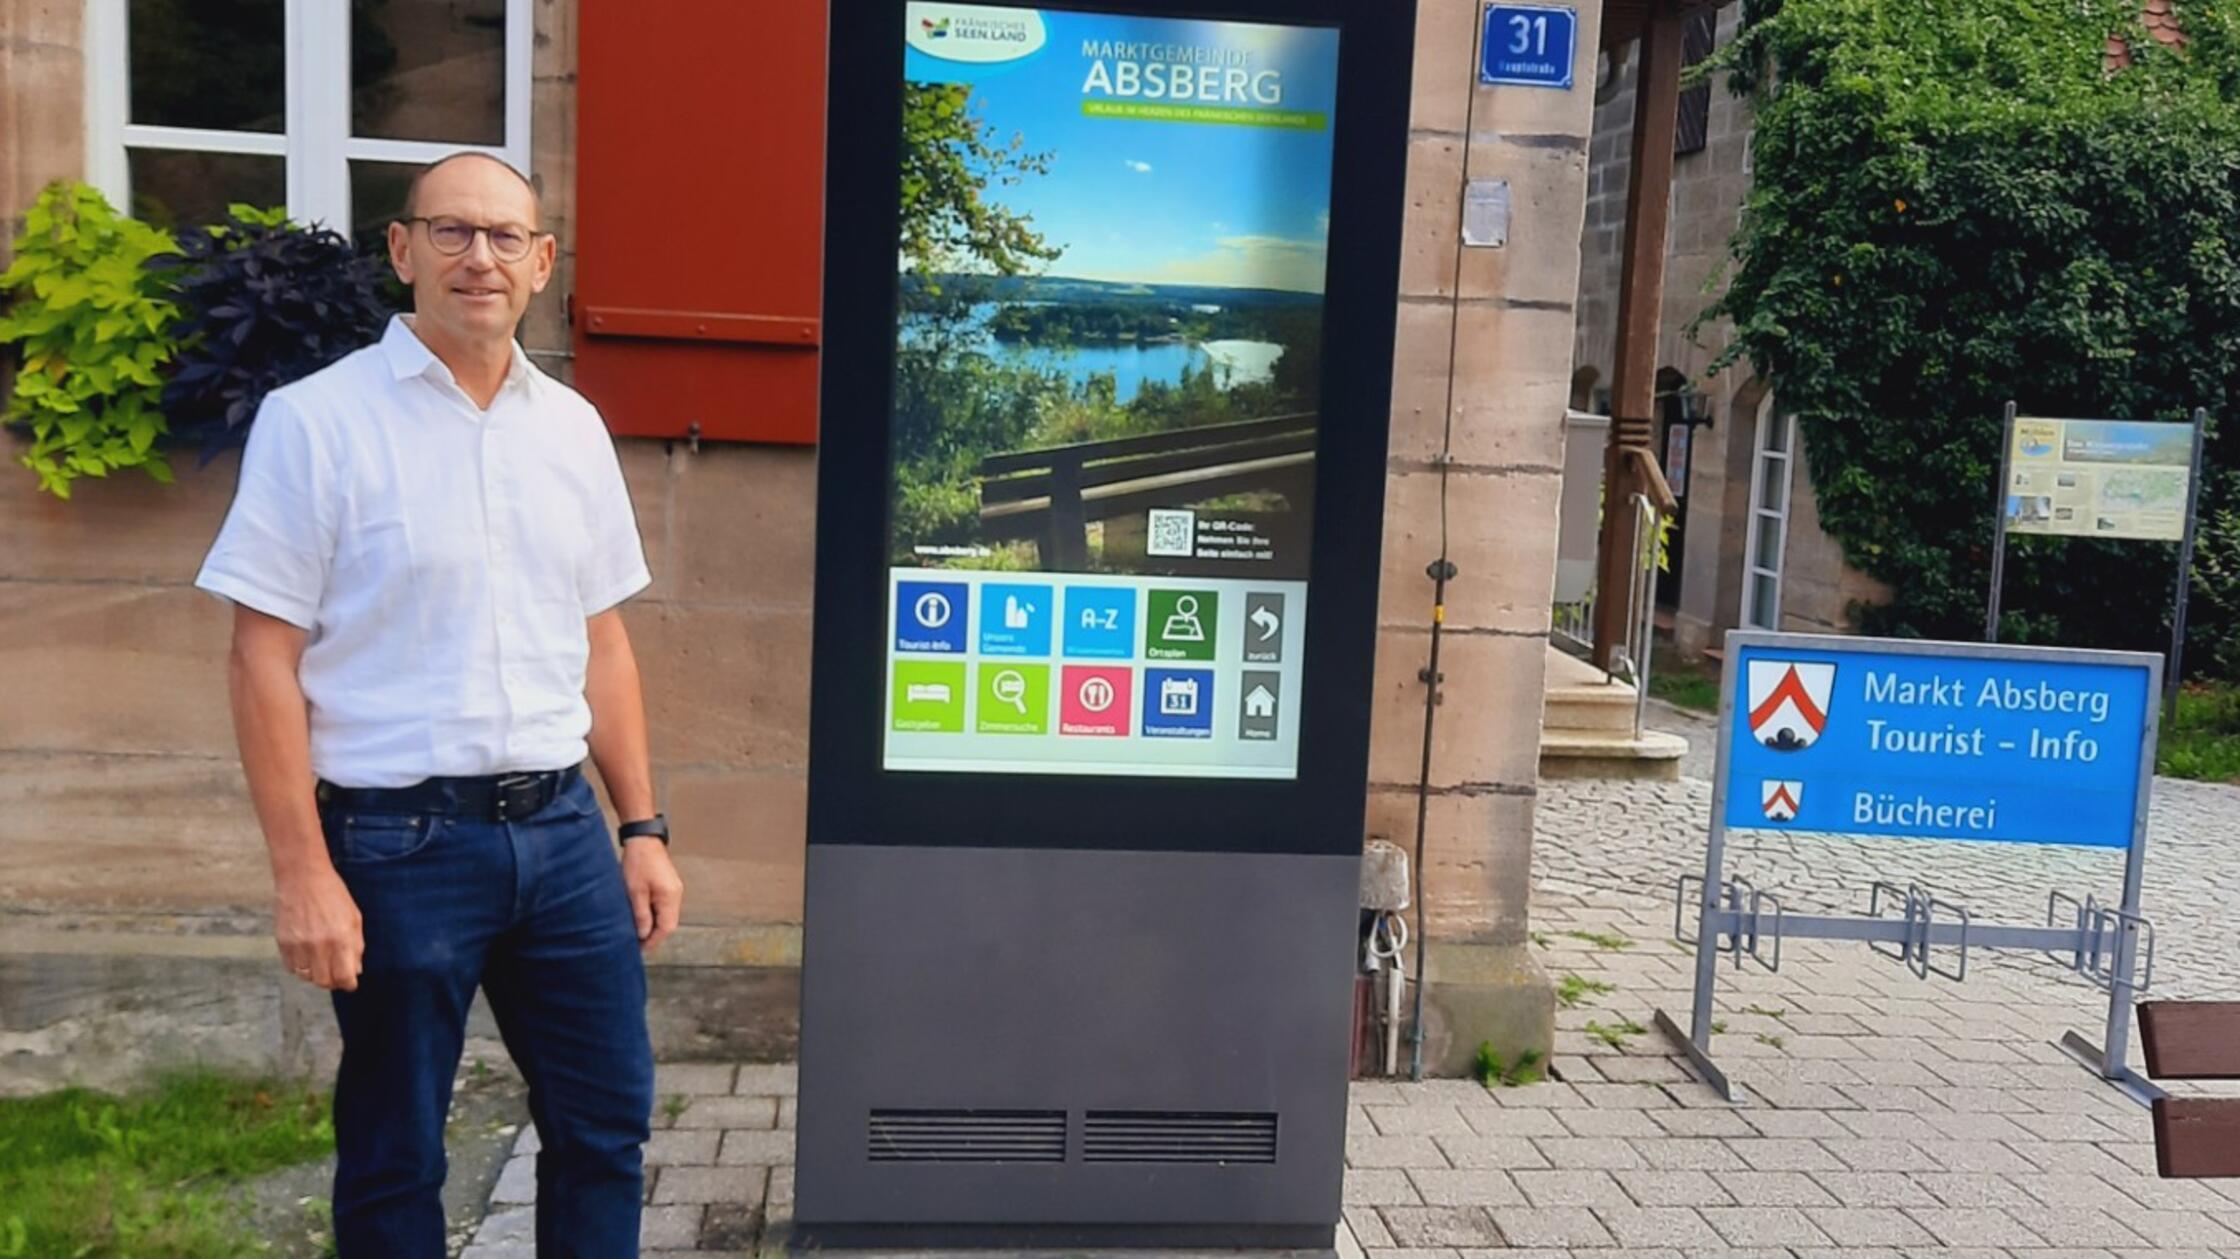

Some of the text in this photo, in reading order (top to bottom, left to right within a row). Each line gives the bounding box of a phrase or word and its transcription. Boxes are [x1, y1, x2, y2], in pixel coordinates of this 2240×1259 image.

[1508, 14, 1547, 55] 31
[1082, 60, 1281, 104] ABSBERG
[1864, 671, 2110, 723] Markt Absberg
[1866, 719, 1986, 757] Tourist
[2030, 728, 2099, 763] Info
[1853, 792, 1997, 830] Bücherei
